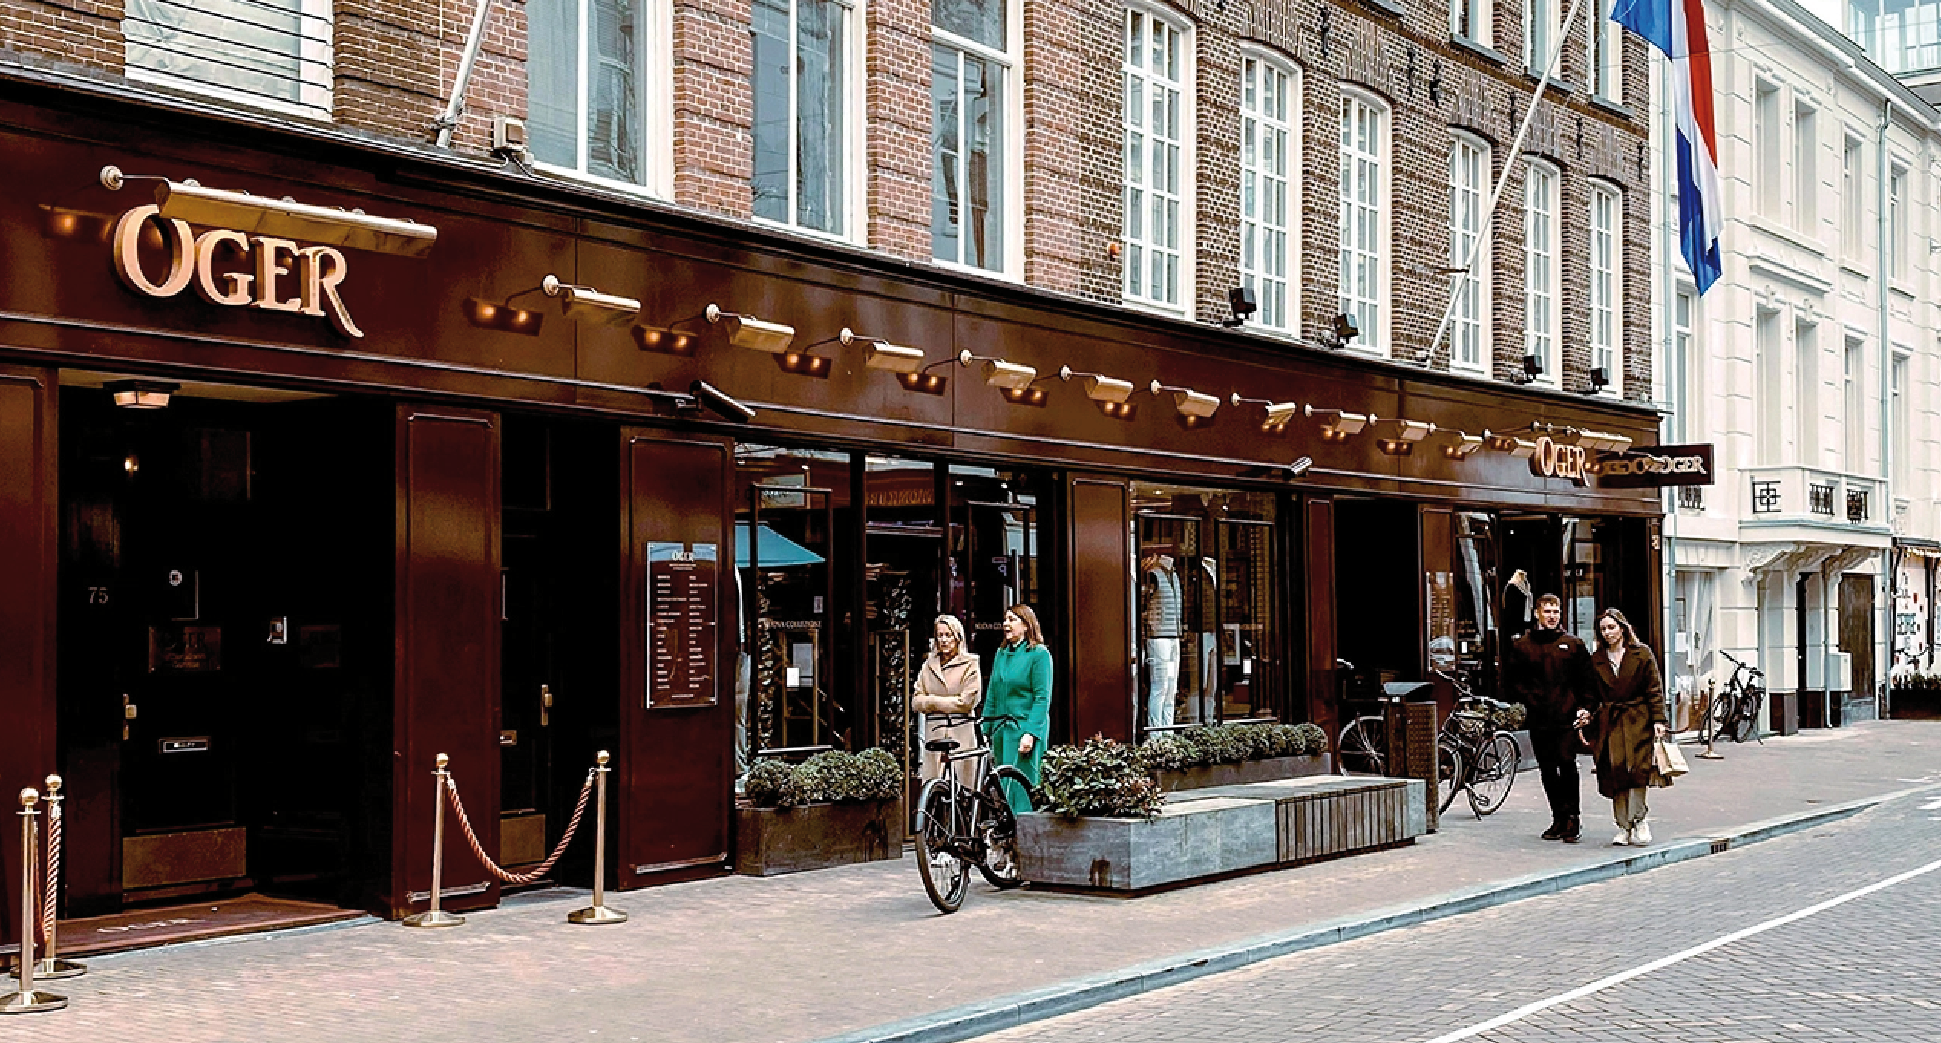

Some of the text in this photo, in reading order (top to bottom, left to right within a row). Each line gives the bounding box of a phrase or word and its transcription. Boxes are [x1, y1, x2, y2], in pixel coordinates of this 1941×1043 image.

[114, 204, 365, 338] OGER
[1536, 436, 1591, 486] OGER
[87, 586, 109, 604] 75
